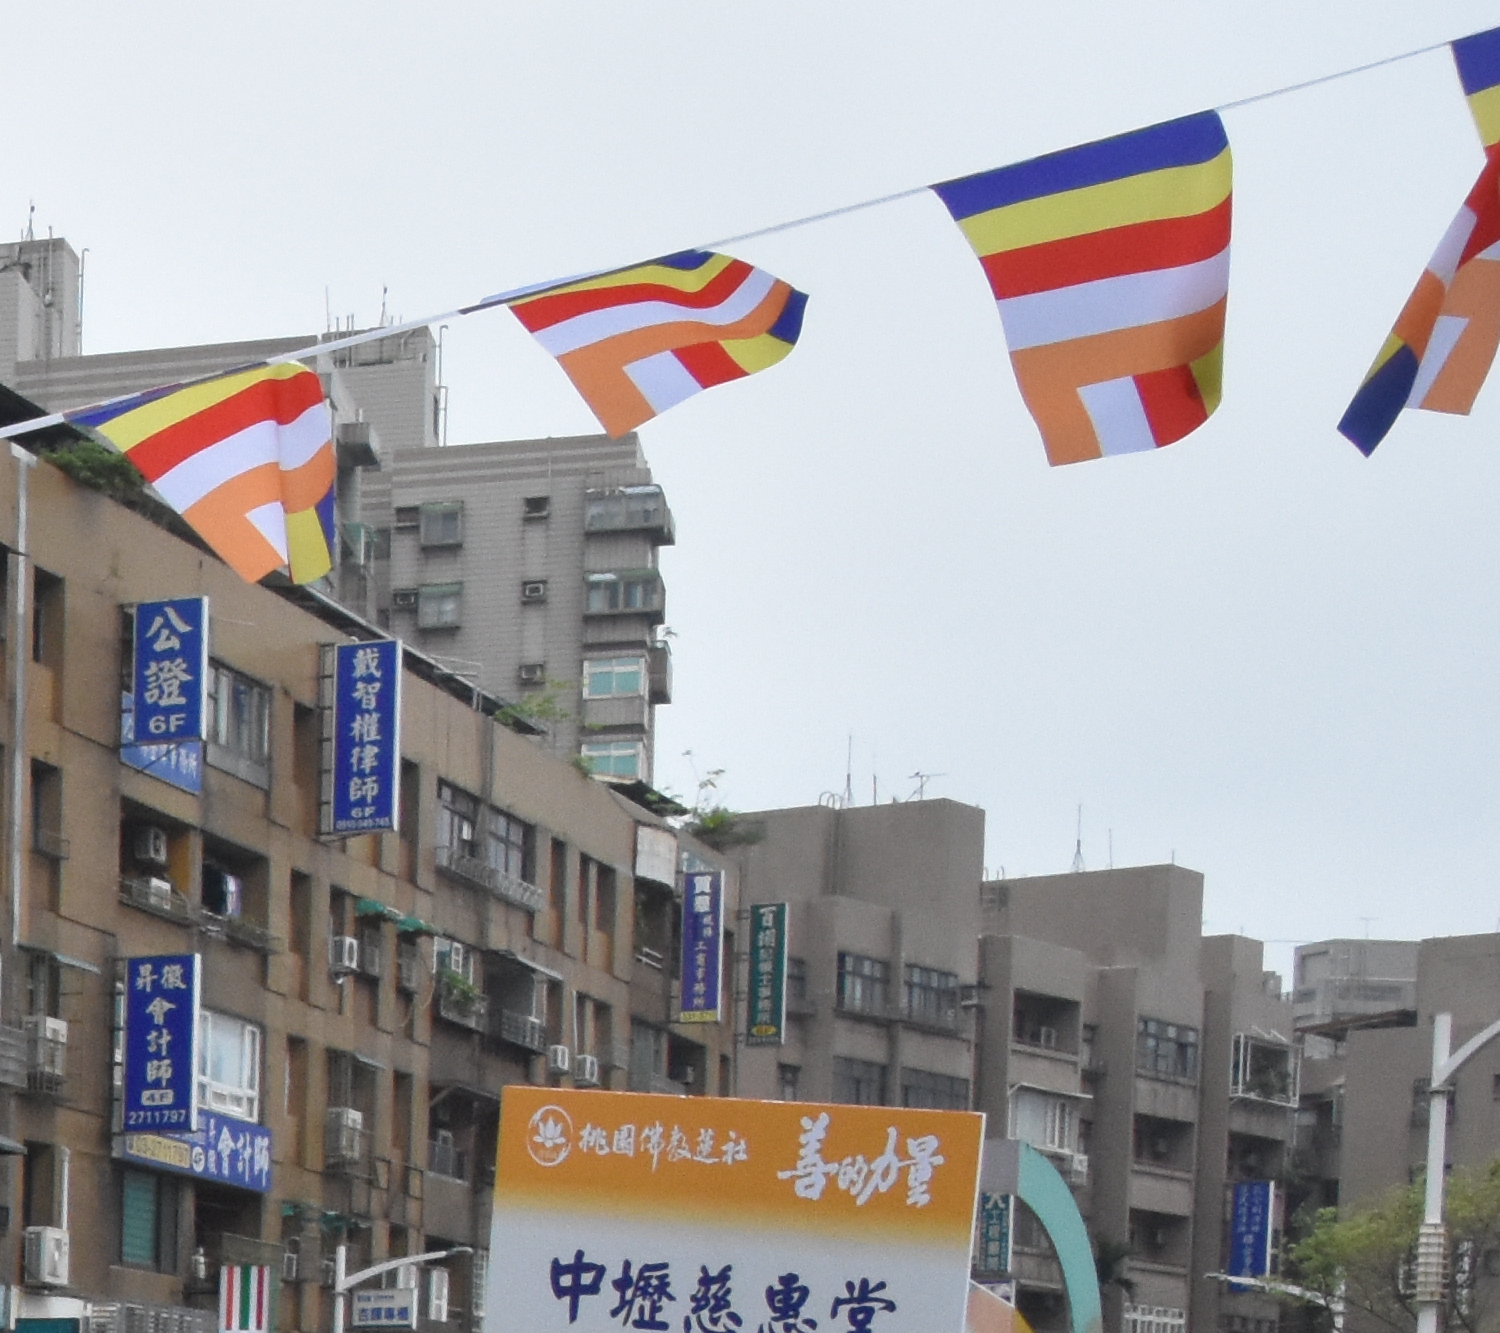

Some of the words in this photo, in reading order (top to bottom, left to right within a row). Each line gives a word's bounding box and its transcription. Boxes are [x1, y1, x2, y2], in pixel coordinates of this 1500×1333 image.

[144, 605, 194, 706] 公證
[148, 714, 186, 734] 6F
[145, 997, 177, 1087] 會計師
[129, 1110, 186, 1125] 2711797
[578, 1124, 748, 1172] 桃園佛教蓮社
